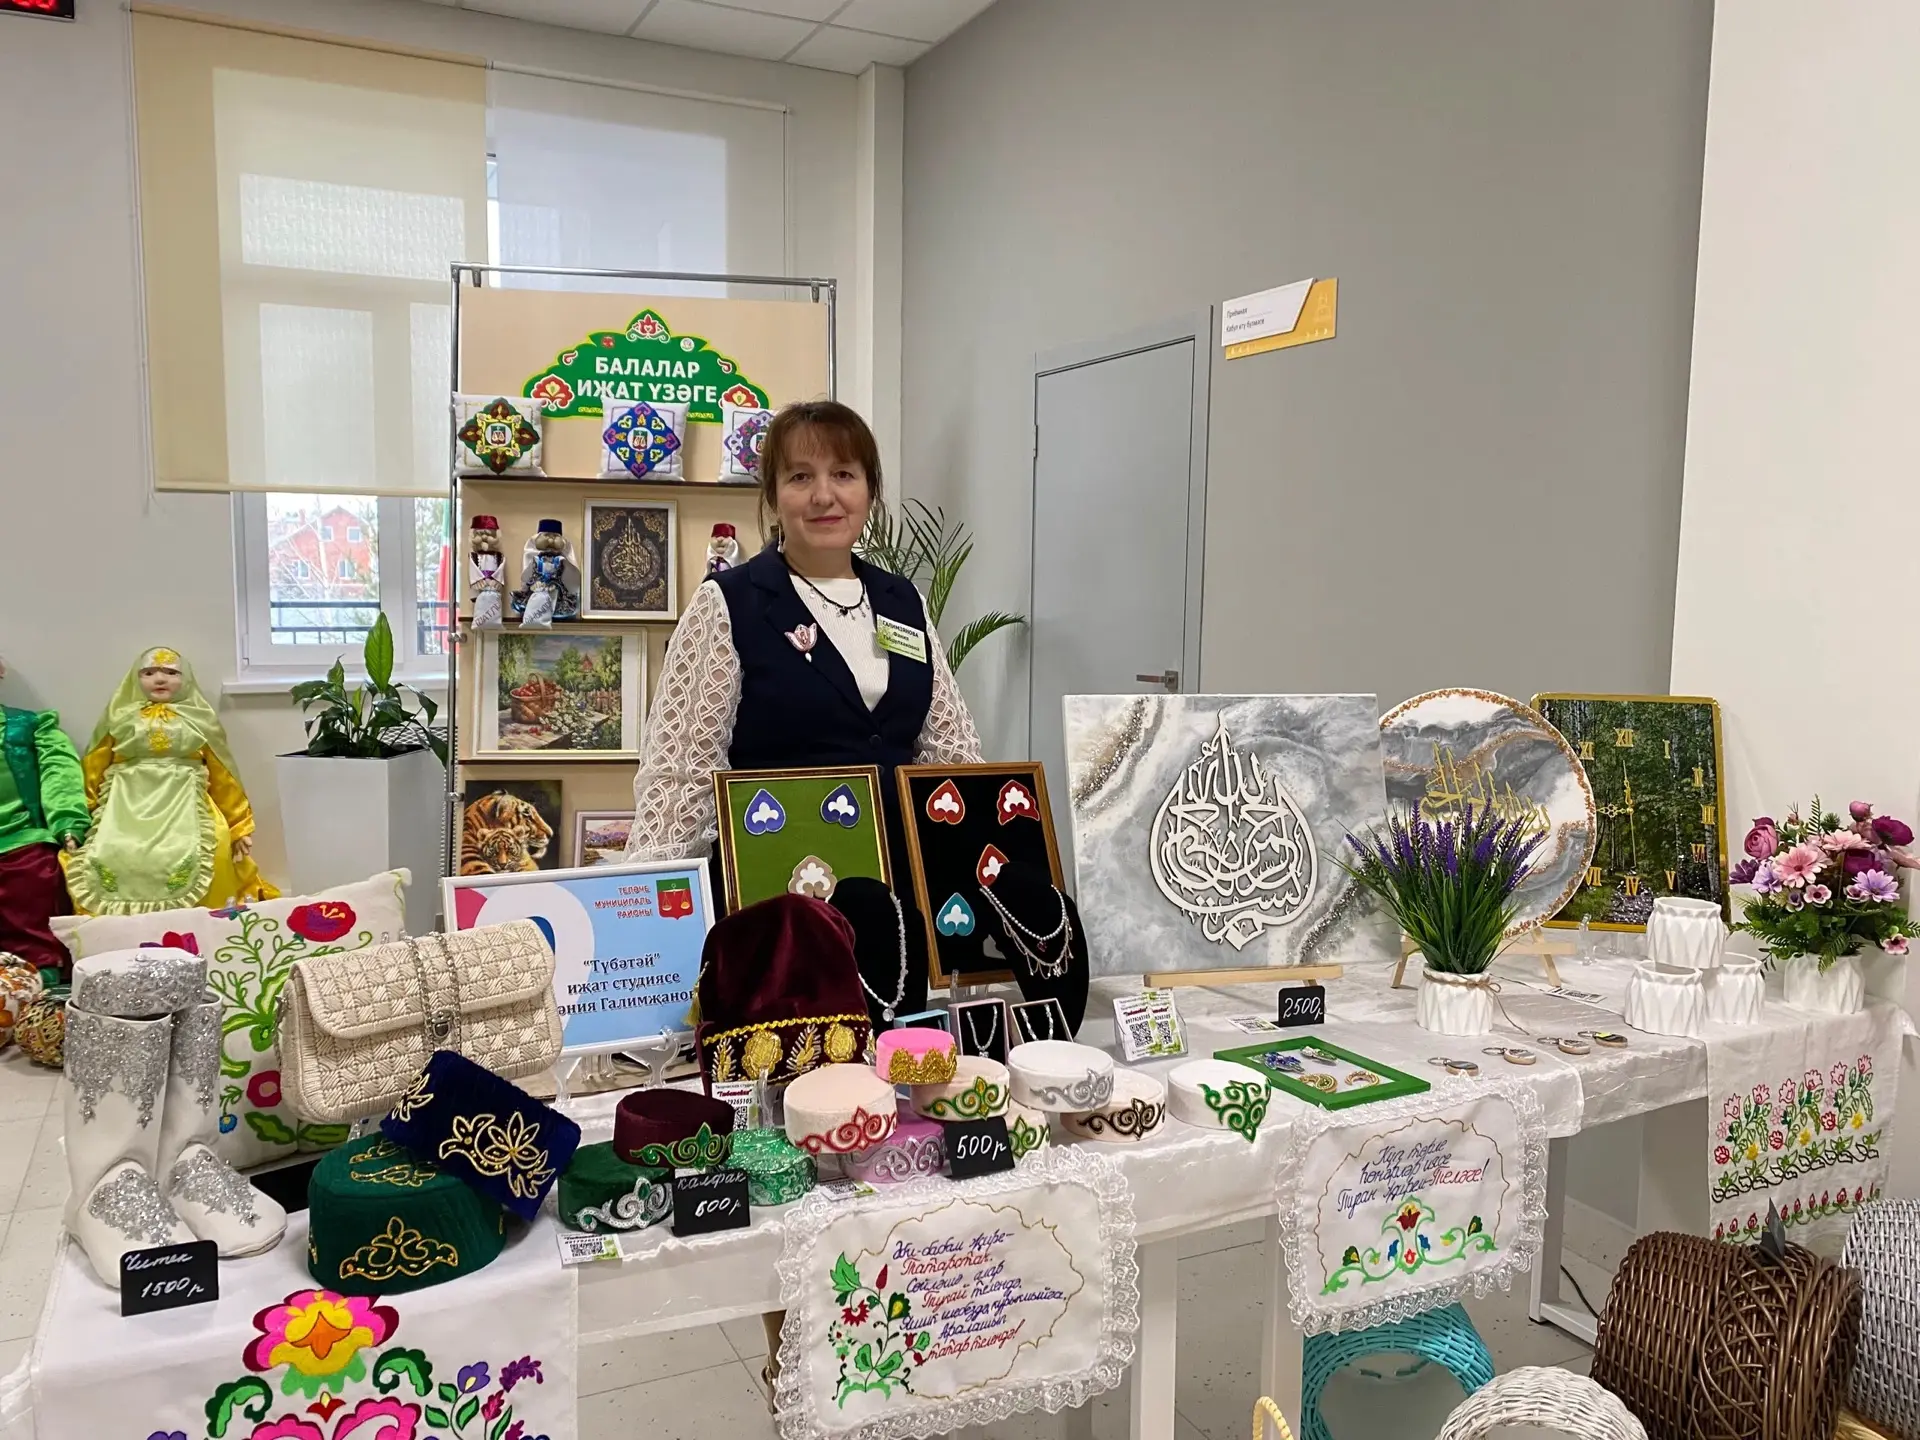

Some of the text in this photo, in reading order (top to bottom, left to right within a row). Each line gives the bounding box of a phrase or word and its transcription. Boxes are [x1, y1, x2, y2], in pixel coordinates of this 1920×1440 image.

[595, 356, 700, 379] БАЛАЛАР
[577, 379, 717, 403] ИҖАТ ҮЗӘГЕ
[1614, 728, 1634, 747] XII
[618, 885, 651, 895] ТЕЛӘЧЕ
[594, 897, 652, 909] МУНИЦИПАЛЬ
[617, 908, 653, 920] РАЙОНЫ
[567, 971, 680, 997] иҗат студиясе
[557, 1002, 597, 1018] әния
